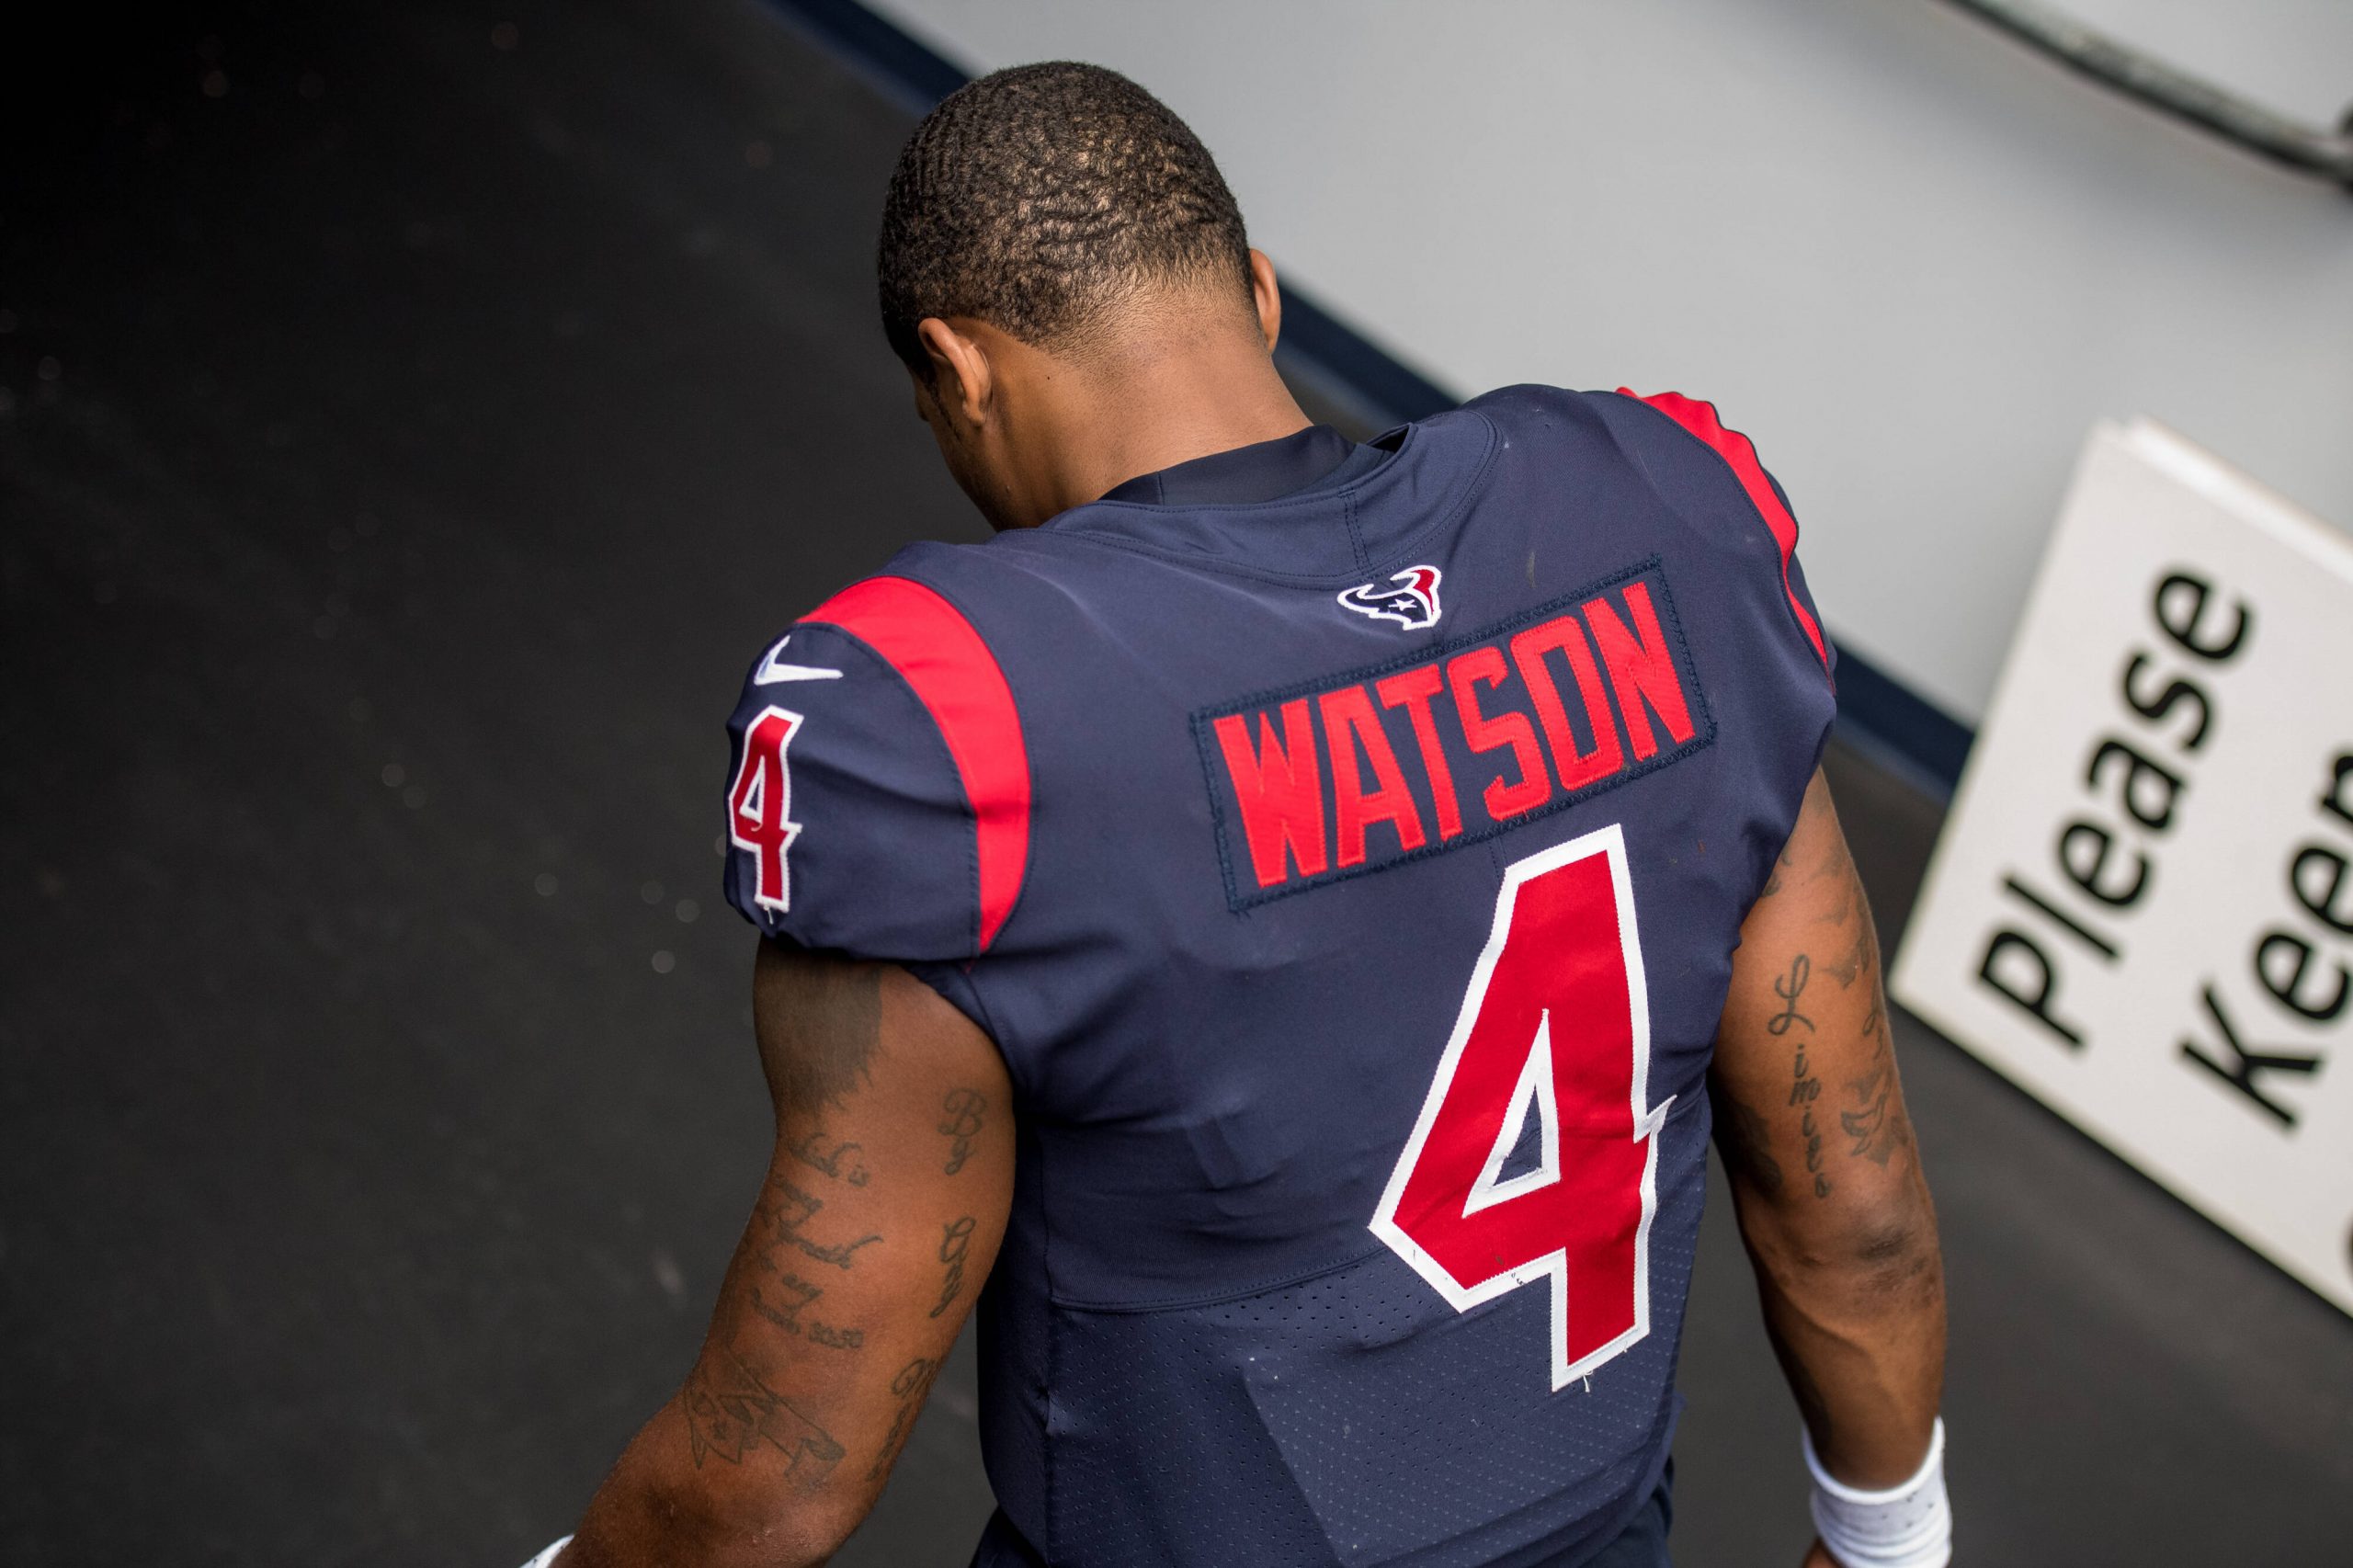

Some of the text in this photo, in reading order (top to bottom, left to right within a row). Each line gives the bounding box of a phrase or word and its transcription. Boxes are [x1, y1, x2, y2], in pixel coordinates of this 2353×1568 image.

[728, 704, 804, 914] 4
[1213, 581, 1695, 888] WATSON
[1972, 566, 2255, 1051] Please
[1369, 823, 1677, 1392] 4
[2175, 749, 2353, 1132] Kee
